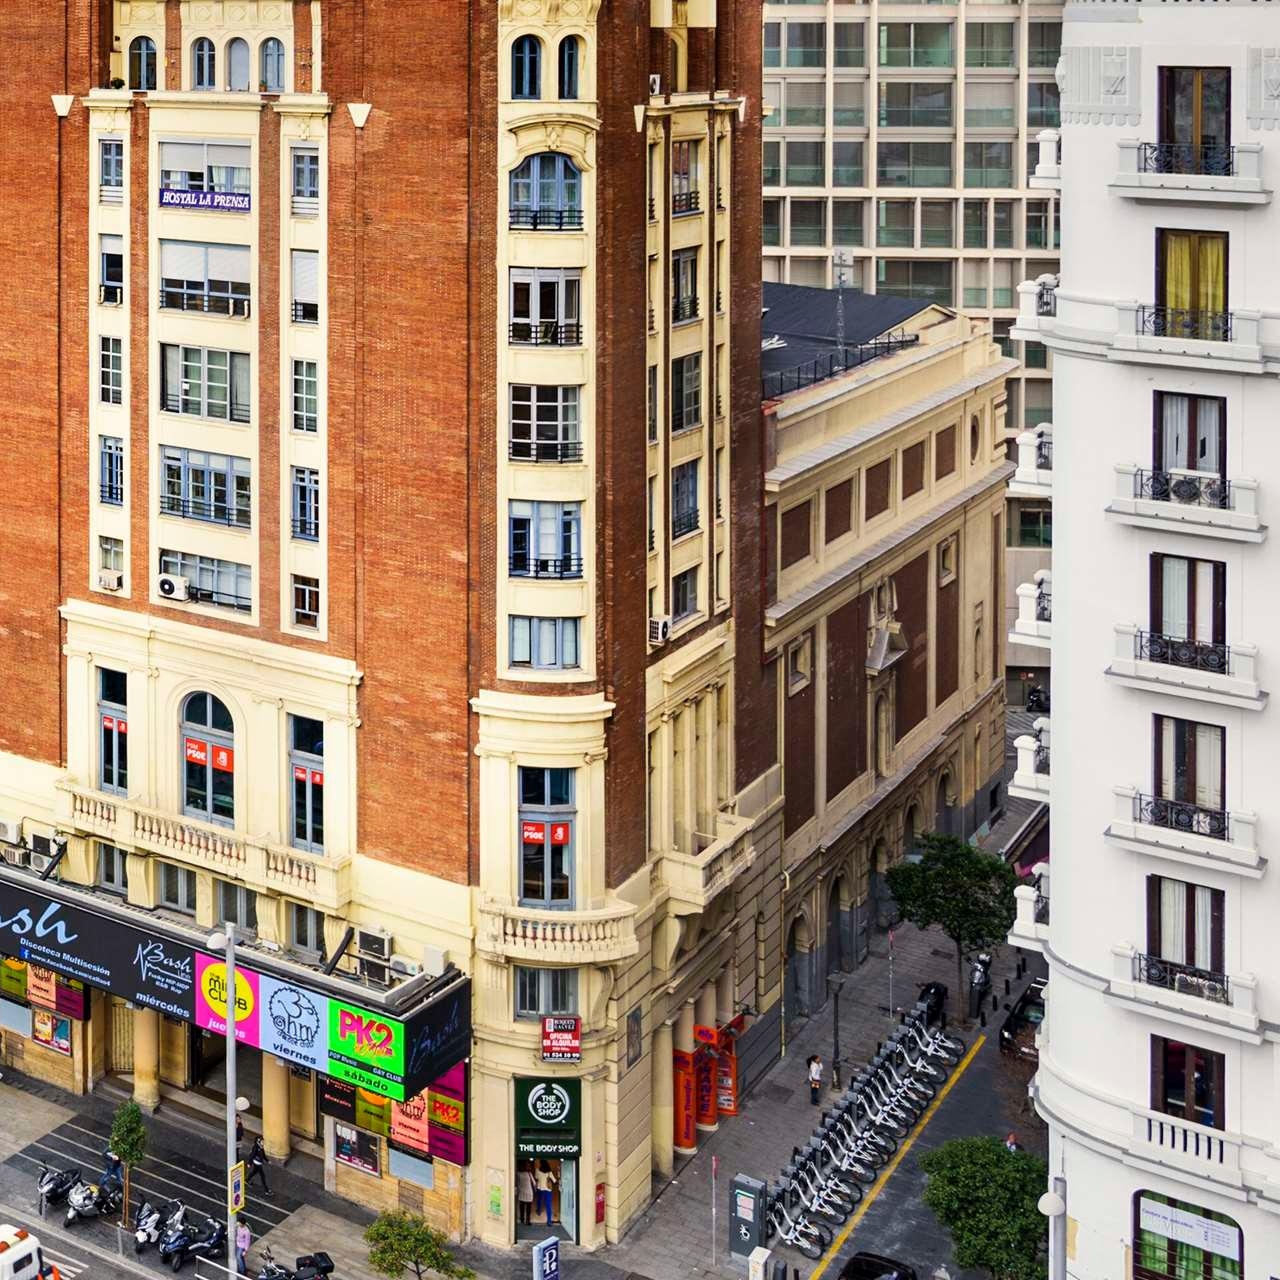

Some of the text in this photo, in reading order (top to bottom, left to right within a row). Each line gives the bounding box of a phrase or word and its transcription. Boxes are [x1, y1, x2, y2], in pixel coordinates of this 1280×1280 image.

[162, 191, 249, 208] HOSTAL LA PRENSA
[187, 748, 206, 760] PSOE
[524, 831, 544, 840] PSOE
[20, 937, 61, 958] Discoteca
[62, 952, 111, 976] Multisesión
[143, 940, 192, 973] Bash
[136, 992, 190, 1018] miércoles
[340, 1009, 393, 1048] PK2
[549, 1032, 572, 1040] OFICINA
[552, 1039, 579, 1047] ALQUILER
[273, 1043, 317, 1064] viernes
[344, 1069, 388, 1091] sábado
[373, 1067, 385, 1076] GAY
[386, 1071, 402, 1082] CLUB
[536, 1101, 562, 1110] BODY
[537, 1108, 561, 1116] SHOP
[519, 1144, 579, 1153] THE BODY SHOP
